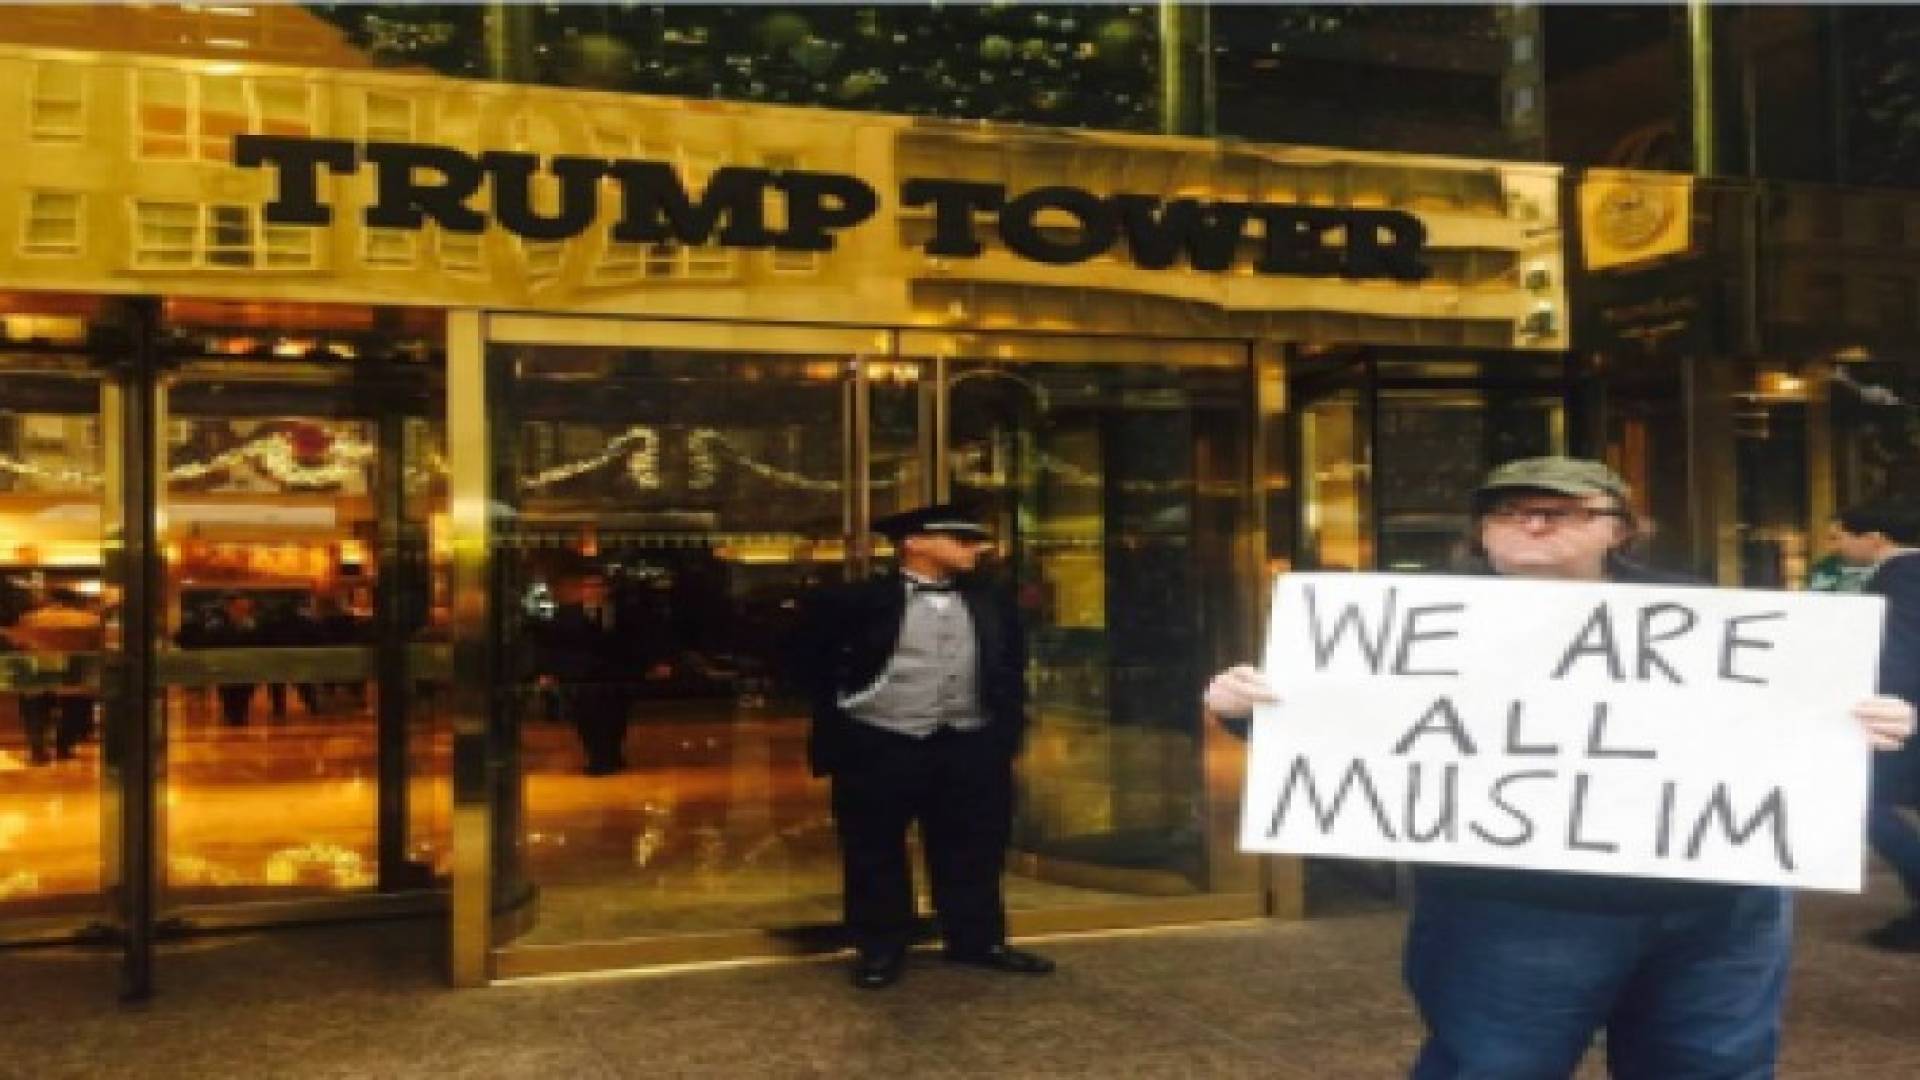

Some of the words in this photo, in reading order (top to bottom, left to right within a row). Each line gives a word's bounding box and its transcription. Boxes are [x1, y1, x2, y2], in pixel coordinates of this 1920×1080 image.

[234, 134, 880, 250] TRUMP
[901, 178, 1431, 280] TOWER
[1303, 584, 1467, 677] WE
[1550, 600, 1788, 685] ARE
[1392, 696, 1657, 760] ALL
[1266, 755, 1796, 871] MUSLIM
